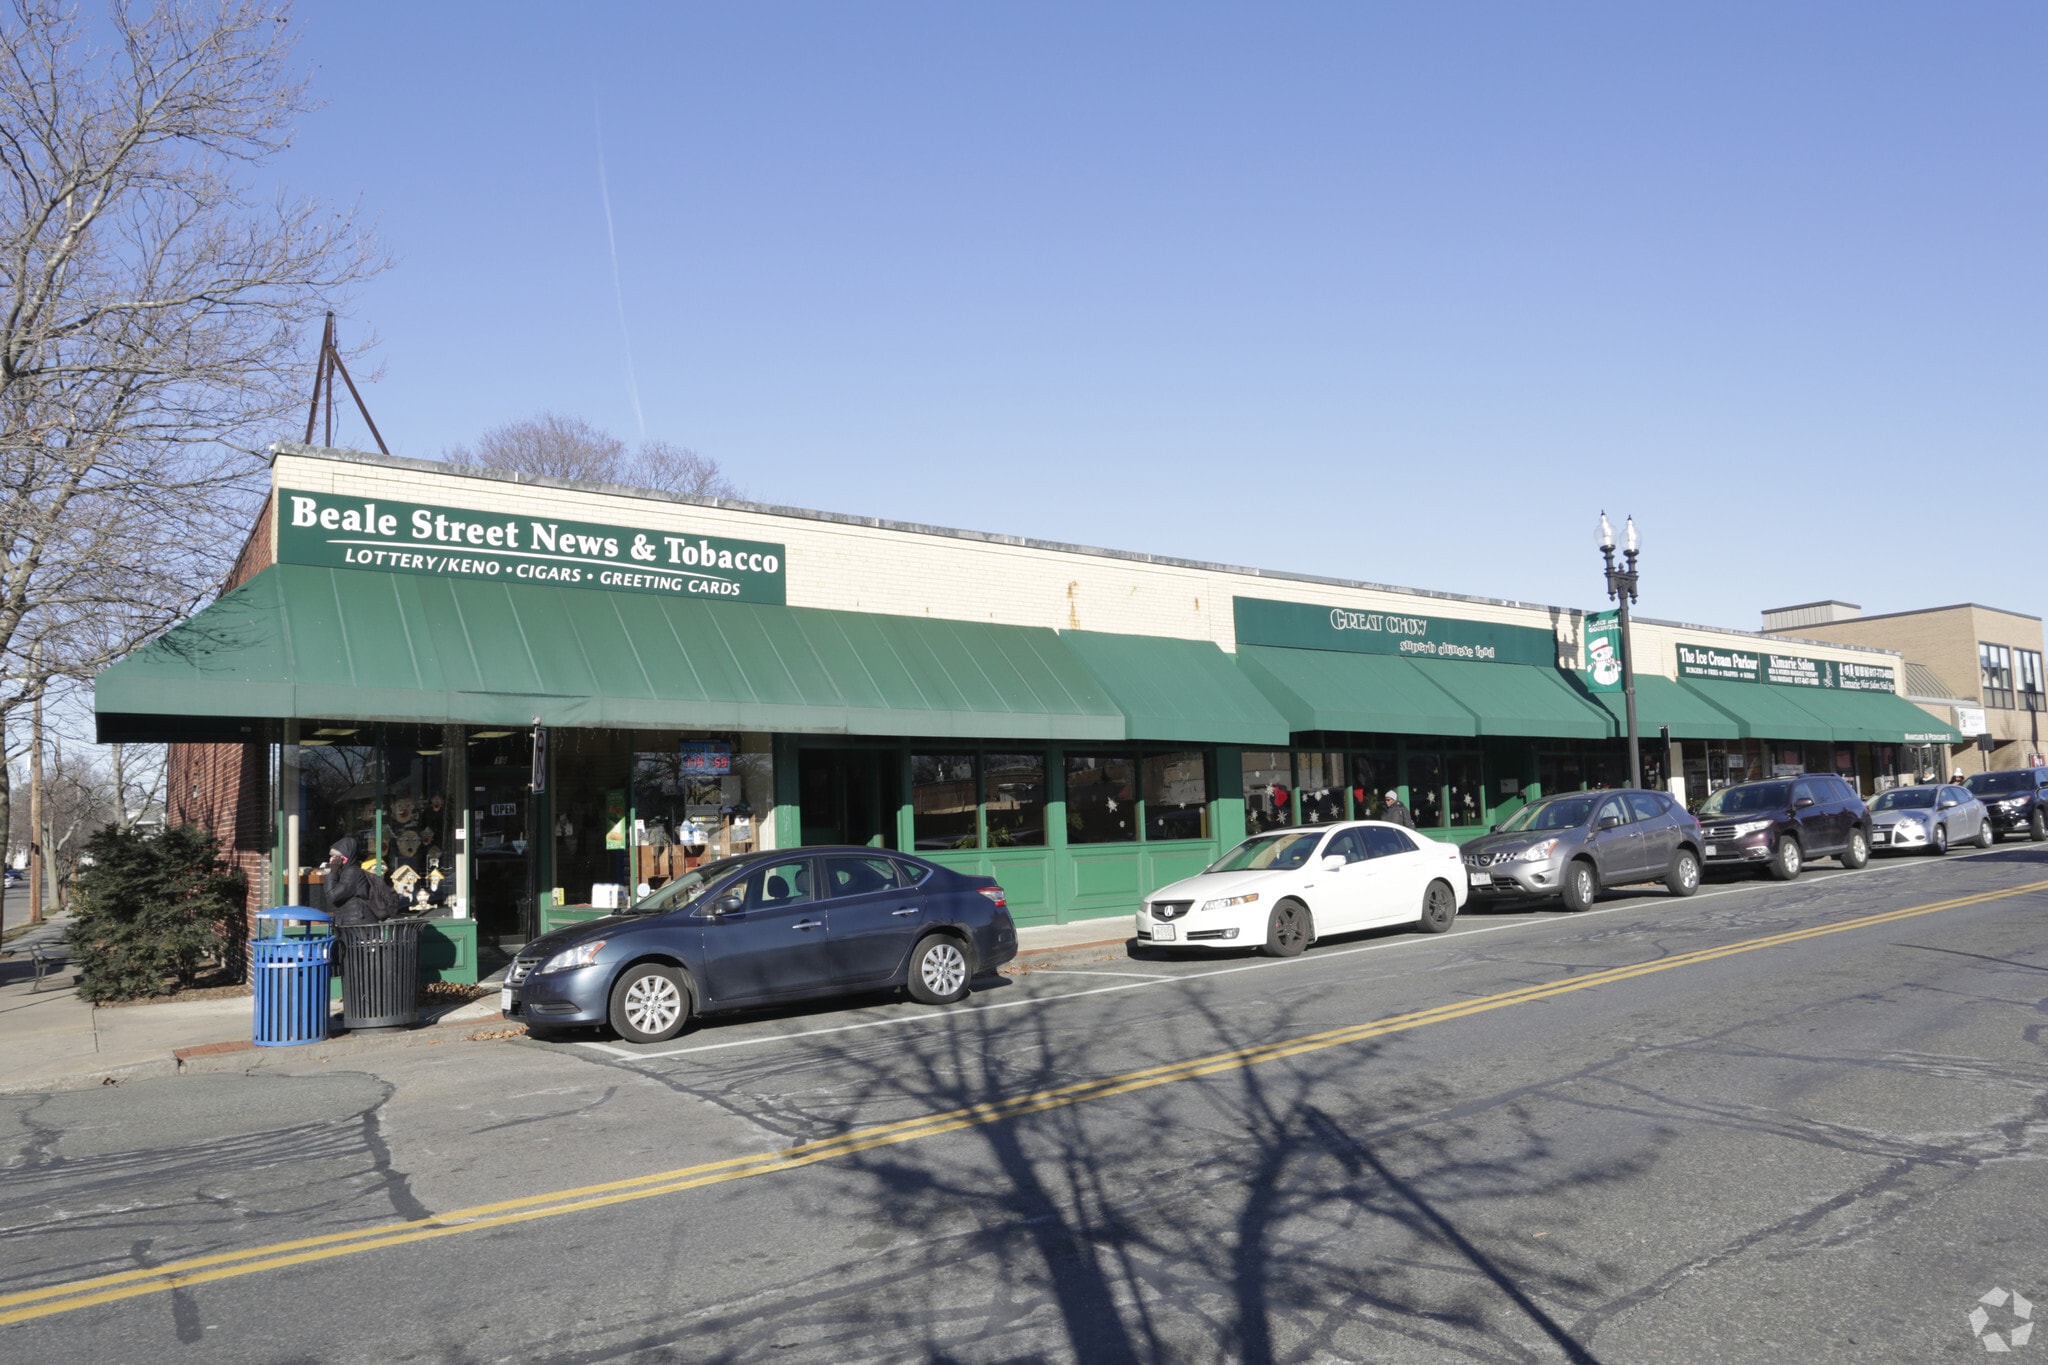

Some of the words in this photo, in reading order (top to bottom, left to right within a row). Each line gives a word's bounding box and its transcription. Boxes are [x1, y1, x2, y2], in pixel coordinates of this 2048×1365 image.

[291, 496, 398, 536] Beale
[411, 509, 519, 548] Street
[530, 522, 619, 558] News
[630, 533, 656, 561] &
[664, 536, 779, 574] Tobacco
[345, 548, 500, 576] LOTTERY/KENO
[516, 563, 581, 582] CIGARS
[600, 570, 683, 592] GREETING
[688, 579, 741, 596] CARDS
[1400, 640, 1436, 654] superb
[1475, 645, 1495, 658] food
[1680, 647, 1695, 663] The
[1695, 649, 1707, 665] Ice
[1708, 651, 1731, 667] Cream
[1732, 653, 1757, 670] Parlour
[1797, 658, 1815, 671] Salon
[493, 804, 515, 815] OPEN
